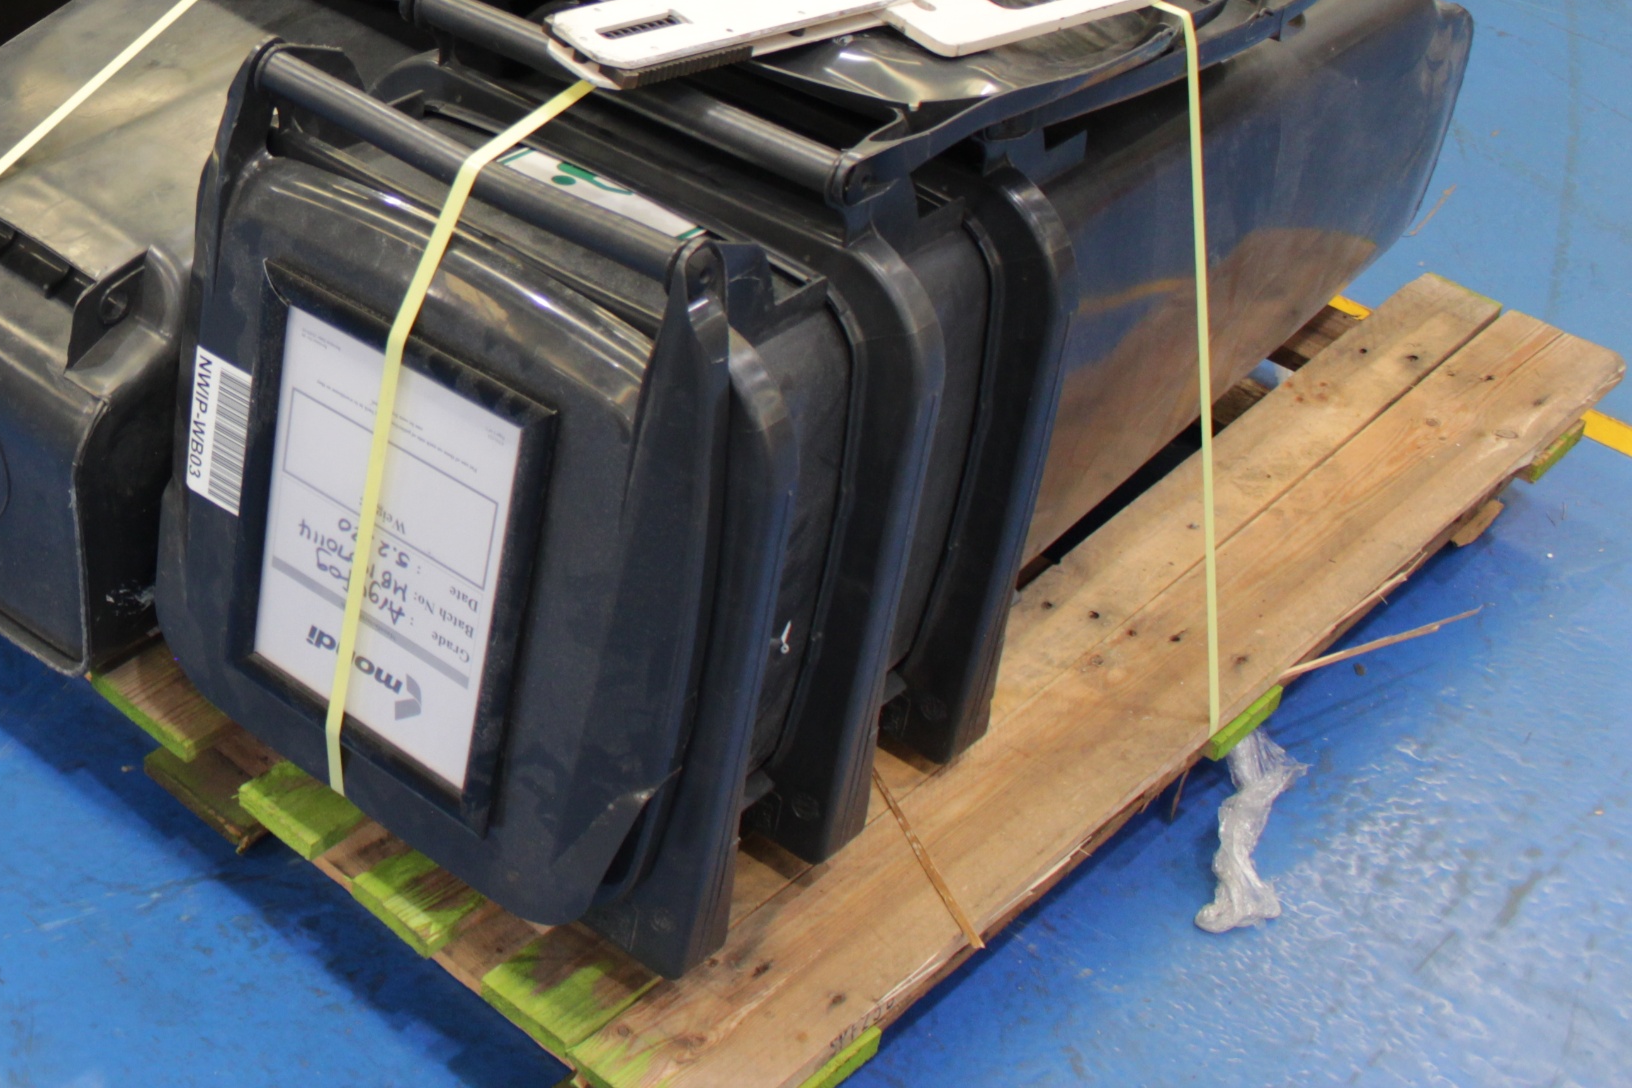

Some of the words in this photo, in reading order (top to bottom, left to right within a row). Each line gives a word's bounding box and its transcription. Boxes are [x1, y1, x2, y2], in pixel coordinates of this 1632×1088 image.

[189, 355, 213, 478] NWIP-WB03
[412, 590, 435, 613] No:
[449, 584, 478, 611] Date
[438, 605, 474, 637] Batch
[430, 629, 470, 663] Grade
